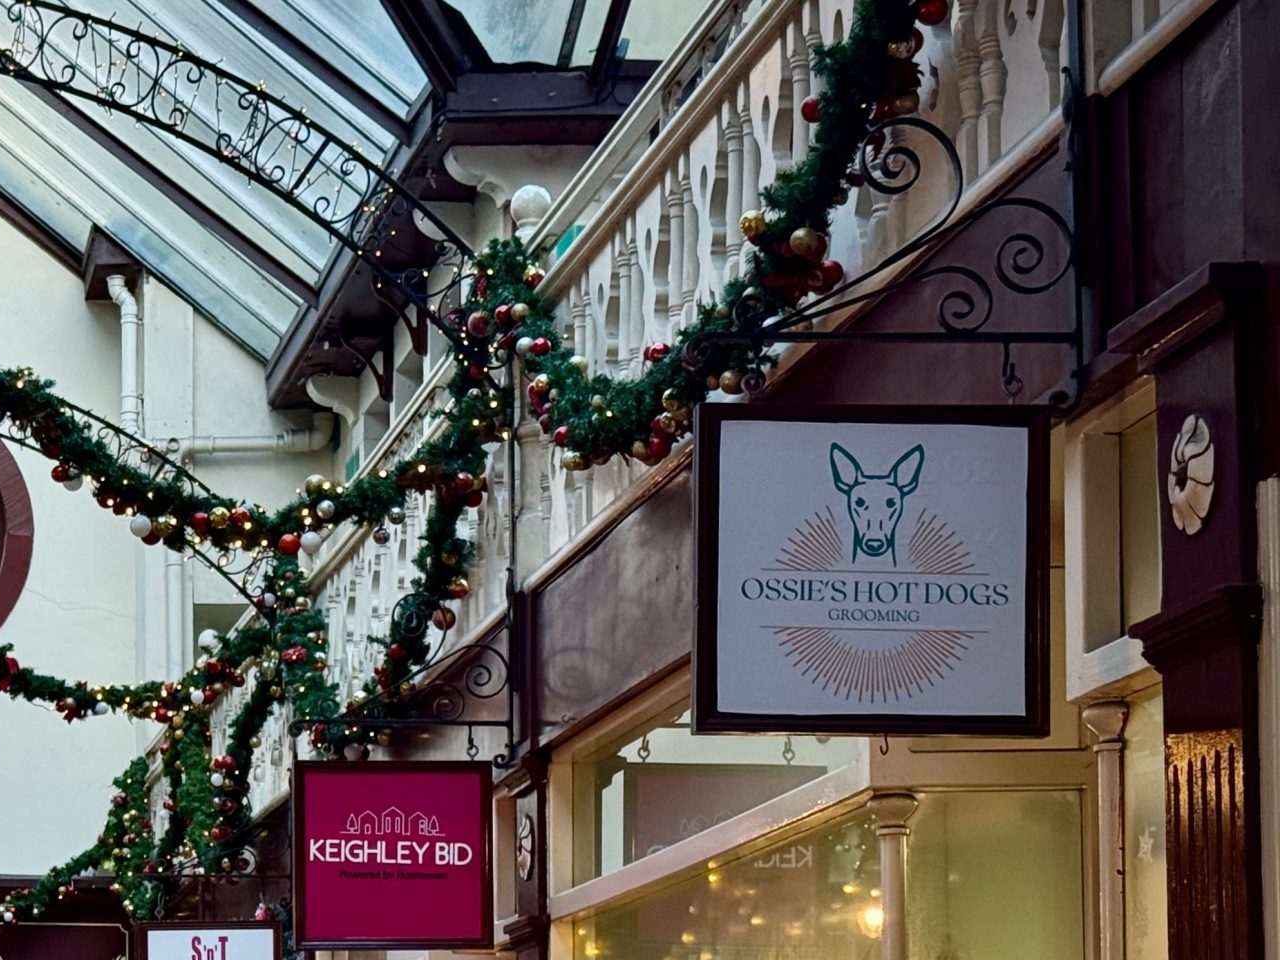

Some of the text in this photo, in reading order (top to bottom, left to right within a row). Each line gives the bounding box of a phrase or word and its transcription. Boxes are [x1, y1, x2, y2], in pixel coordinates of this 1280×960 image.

[740, 577, 1010, 606] OSSIE'S HOT DOGS
[827, 608, 920, 623] GROOMING
[309, 838, 473, 866] KEIGHLEY BID
[338, 869, 381, 879] Powered
[382, 870, 393, 881] by
